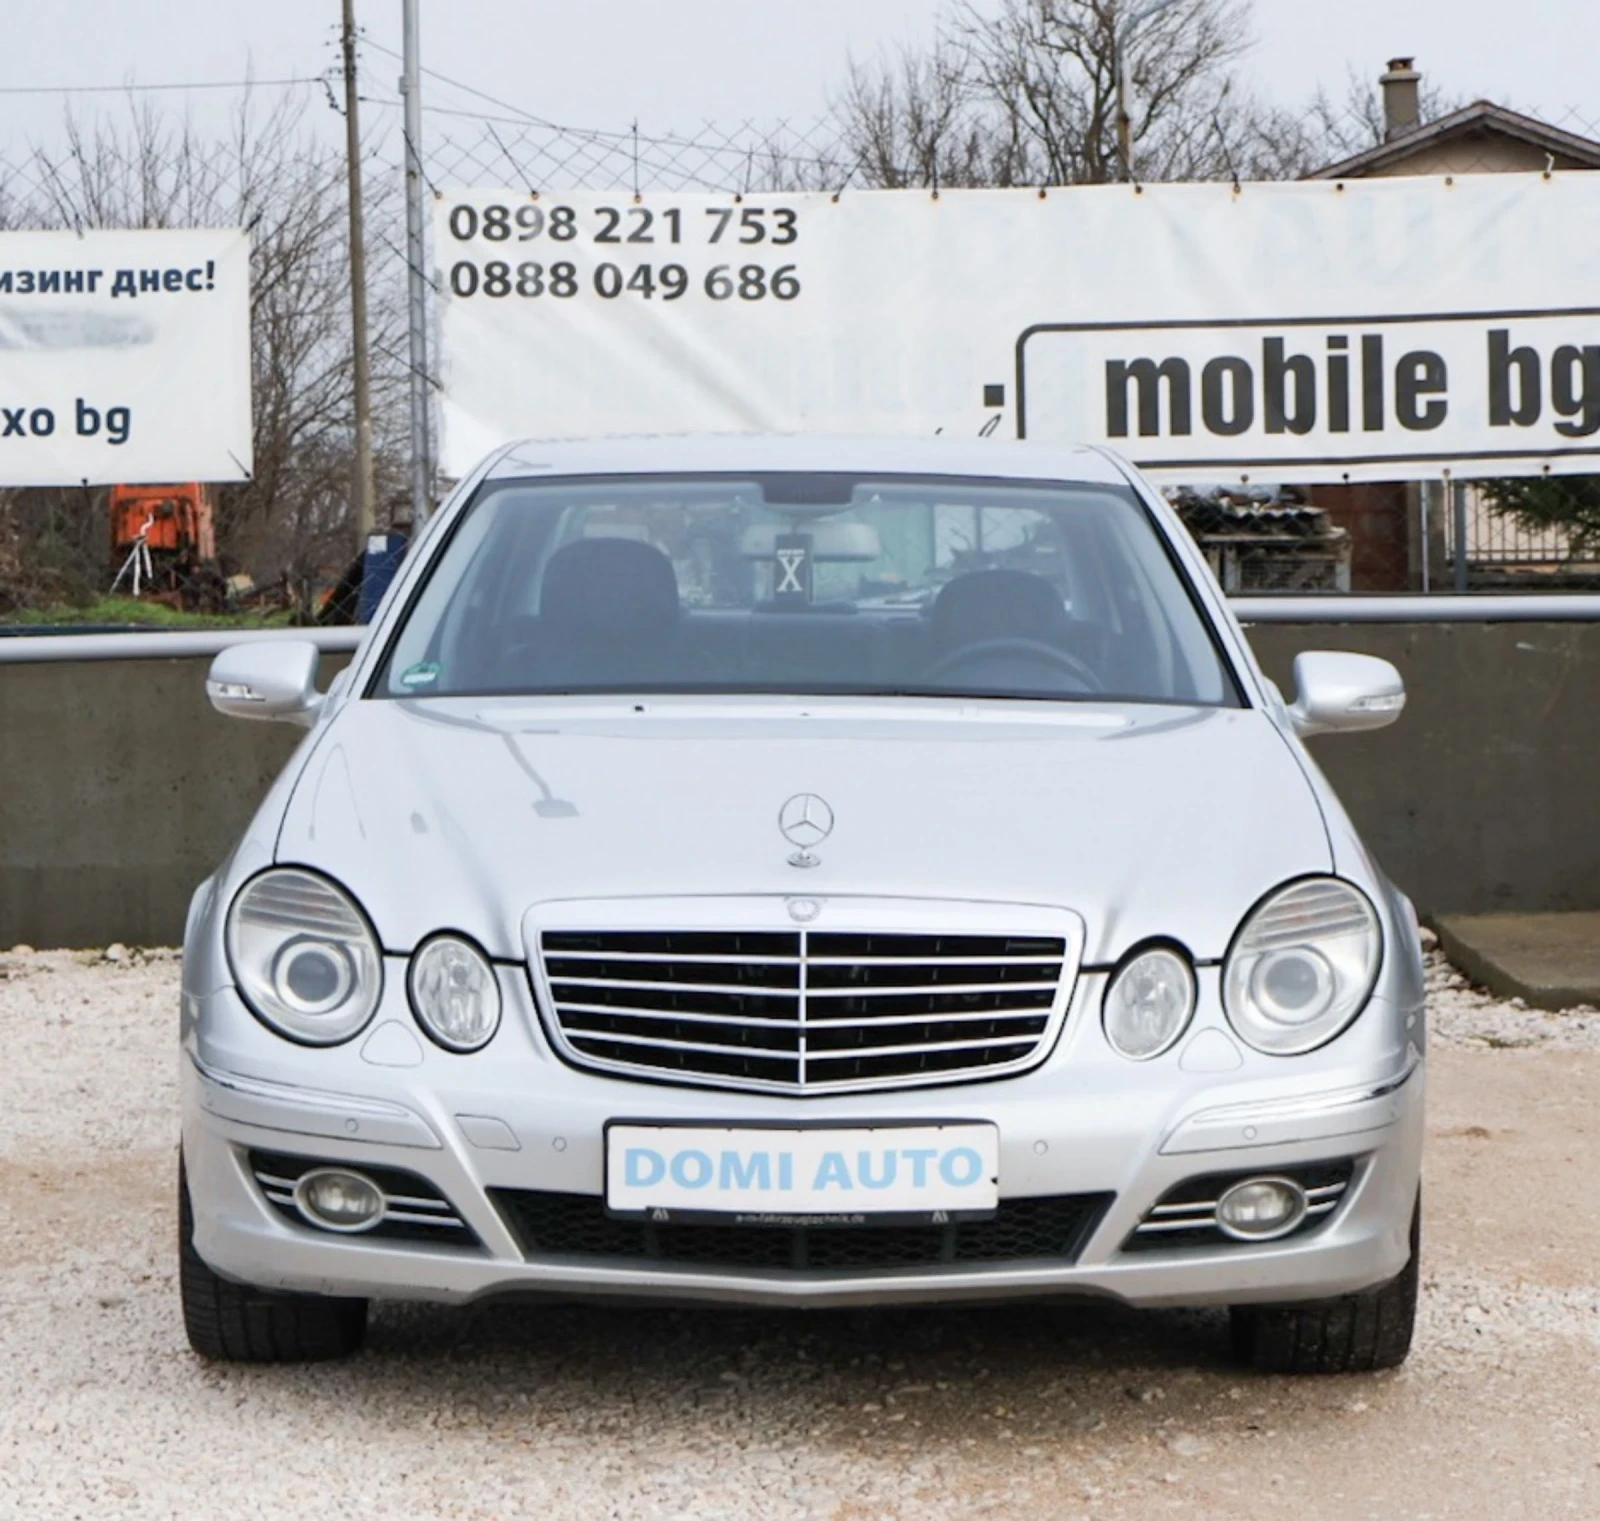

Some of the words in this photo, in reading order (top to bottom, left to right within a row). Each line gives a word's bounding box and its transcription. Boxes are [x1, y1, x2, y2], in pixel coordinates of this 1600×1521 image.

[449, 204, 578, 242] 0898
[593, 206, 681, 244] 221
[705, 207, 798, 246] 753
[110, 259, 215, 299] днес!
[449, 260, 579, 299] 0888
[593, 262, 689, 301] 049
[703, 264, 801, 301] 686
[1104, 333, 1449, 440] mobile
[1486, 328, 1600, 438] bg
[75, 397, 131, 446] bg
[624, 1147, 793, 1191] DOMI
[812, 1146, 984, 1191] AUTO
